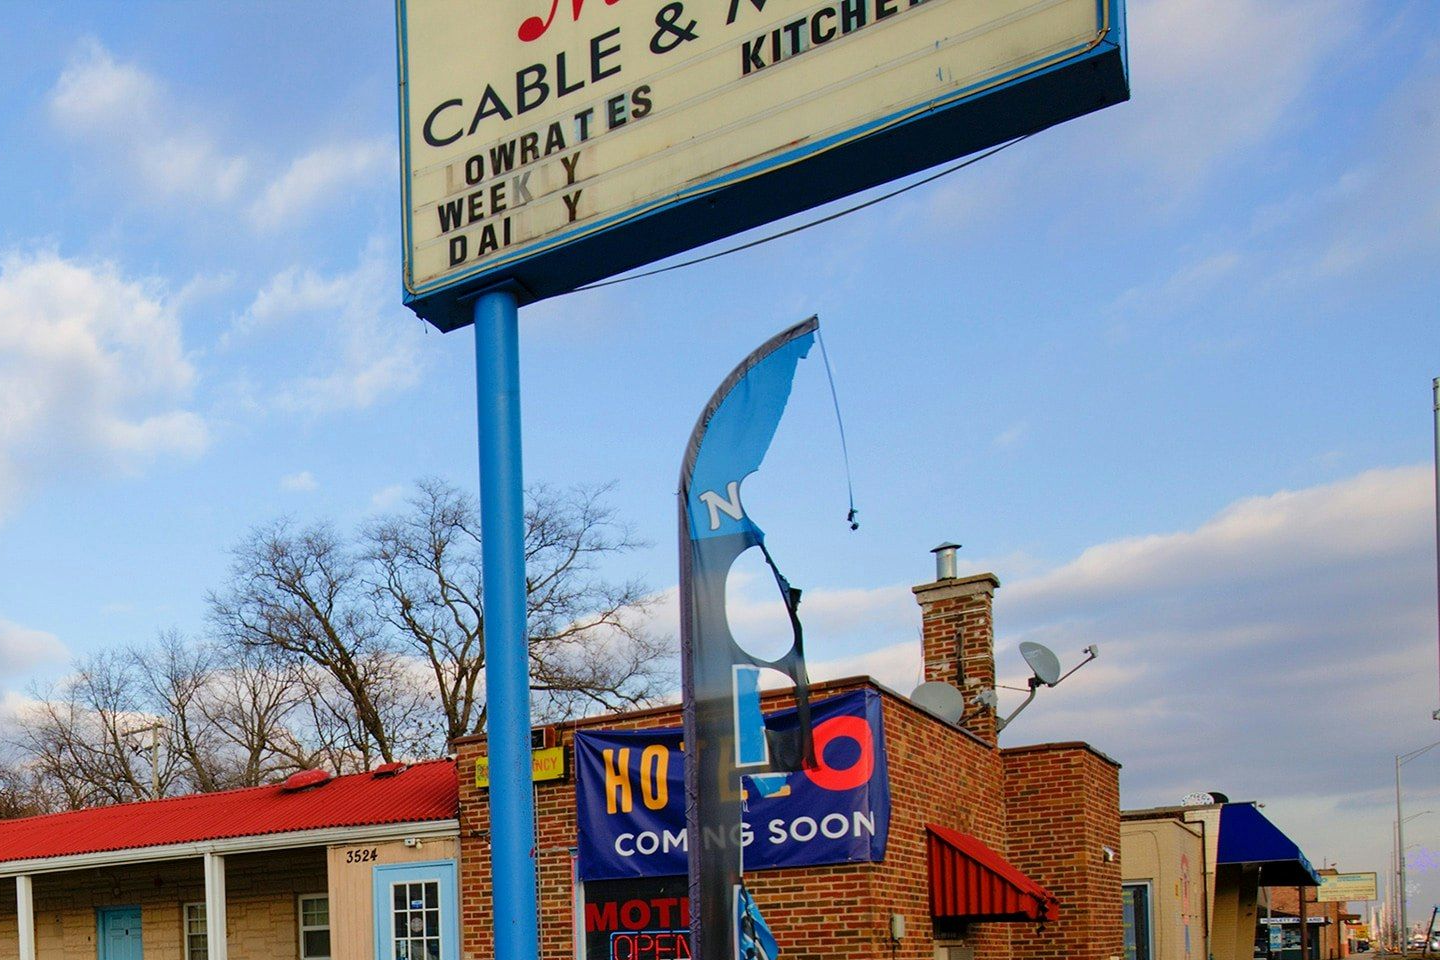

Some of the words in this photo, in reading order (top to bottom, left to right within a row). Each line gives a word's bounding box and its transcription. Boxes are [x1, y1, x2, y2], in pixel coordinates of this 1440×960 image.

[742, 0, 920, 76] KITCHE
[423, 26, 622, 148] CABLE
[649, 1, 700, 55] &
[346, 848, 379, 864] 3524
[614, 822, 755, 857] COMNG
[768, 810, 876, 845] SOON
